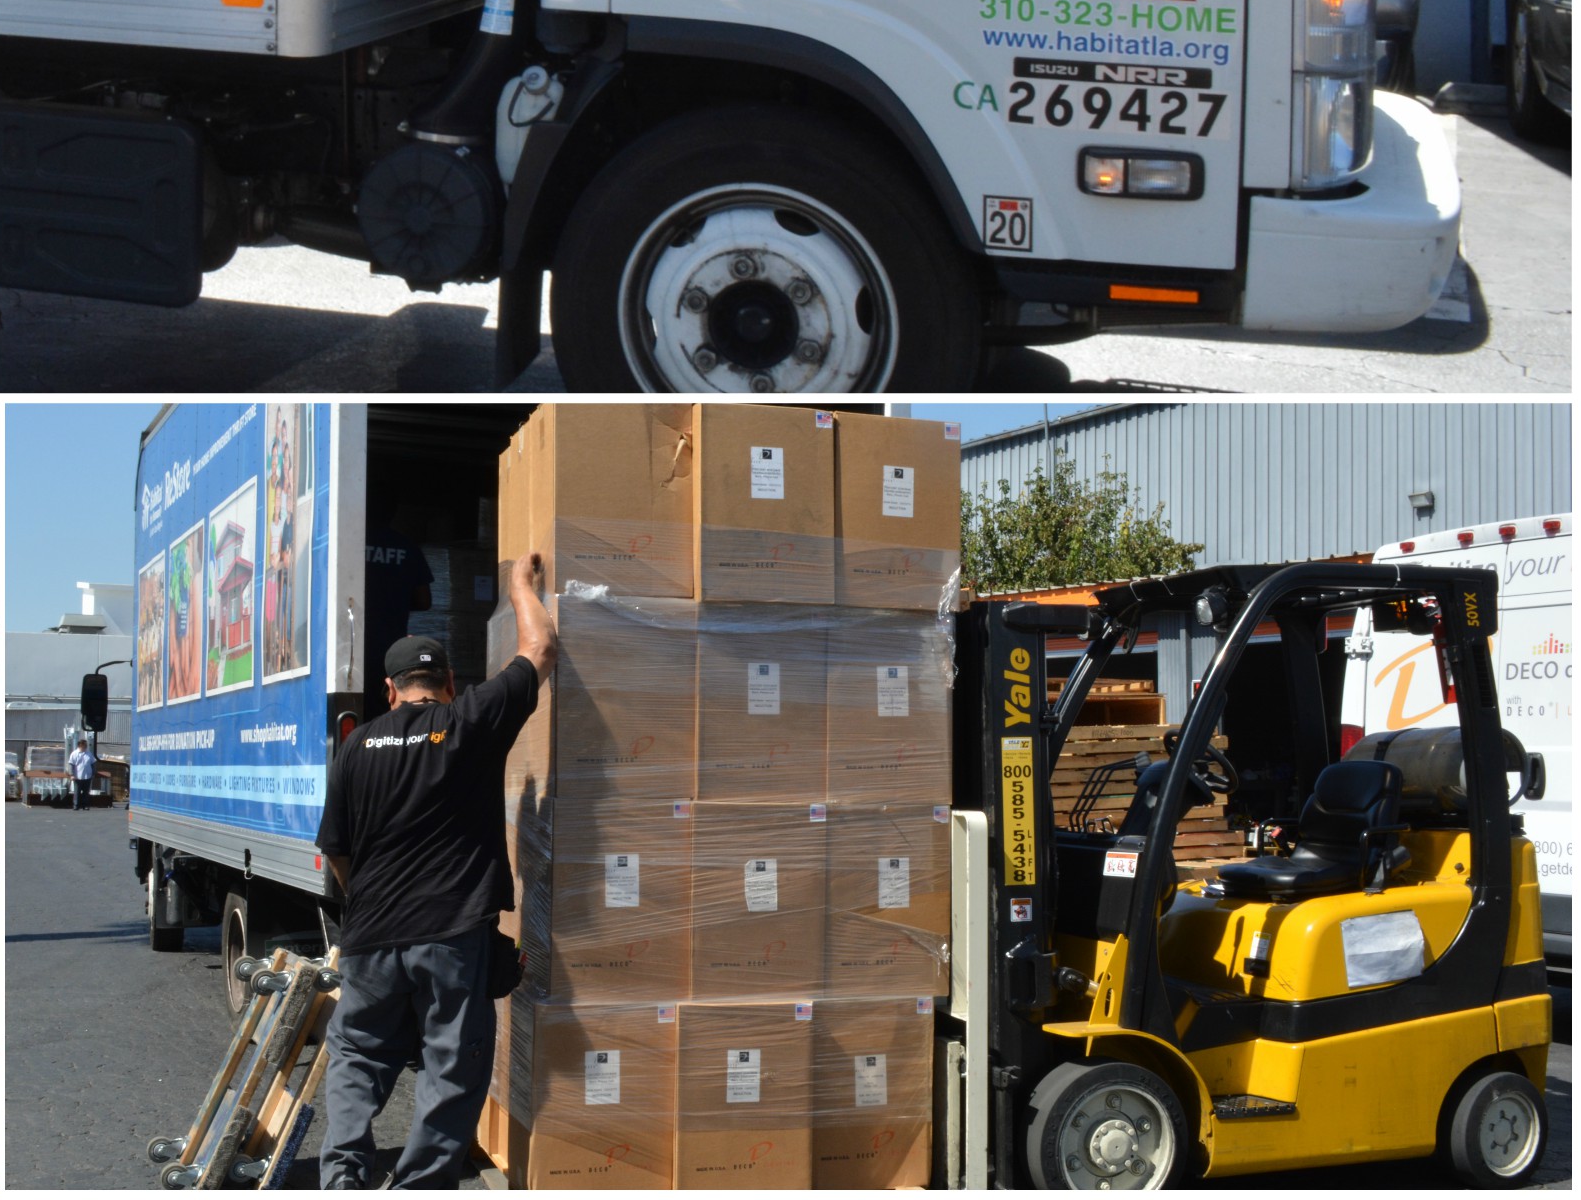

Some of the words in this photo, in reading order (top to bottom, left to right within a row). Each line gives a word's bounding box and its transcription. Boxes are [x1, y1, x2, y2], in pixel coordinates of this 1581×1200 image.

[982, 29, 1229, 65] www.habitatla.org
[1029, 63, 1079, 76] ISUZU
[1094, 64, 1188, 86] NRR
[953, 80, 999, 112] CA
[1008, 81, 1228, 137] 269427
[989, 211, 1026, 246] 20
[366, 546, 406, 565] TAFF
[1505, 554, 1566, 585] your
[1464, 592, 1480, 627] 50VX
[1505, 661, 1559, 681] DECO
[1004, 647, 1031, 728] Yale
[1506, 696, 1522, 706] with
[1506, 705, 1545, 717] DECO
[405, 733, 428, 746] your
[1003, 765, 1032, 779] 800
[229, 776, 251, 791] LIGHTING
[252, 777, 275, 793] FIXTURES
[283, 777, 315, 796] WINDOWS
[1534, 841, 1563, 858] 800)
